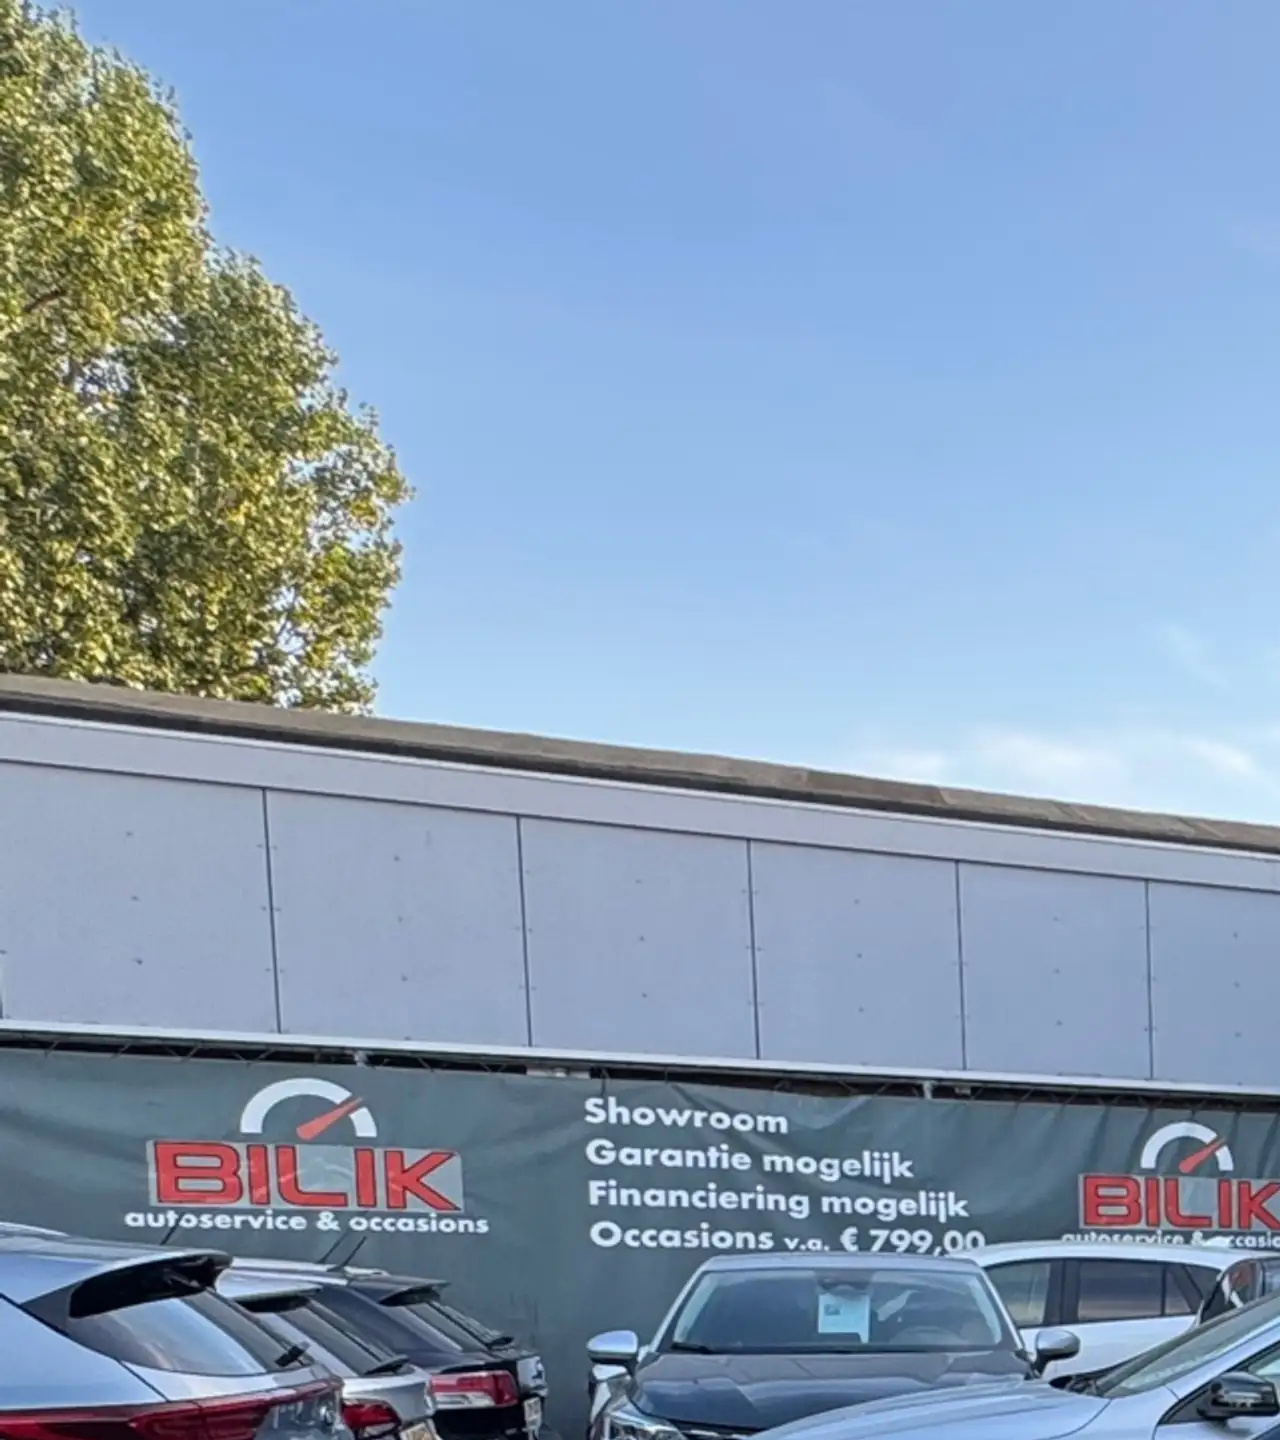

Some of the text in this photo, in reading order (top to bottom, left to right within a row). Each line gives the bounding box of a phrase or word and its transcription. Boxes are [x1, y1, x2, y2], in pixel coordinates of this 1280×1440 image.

[584, 1097, 788, 1134] Showroom
[153, 1140, 461, 1211] BILIK
[585, 1138, 914, 1184] Garantie mogelijk
[587, 1179, 969, 1223] Financiering mogelijk
[124, 1209, 489, 1234] autoservice & occasions
[589, 1221, 774, 1250] Occasions
[784, 1237, 829, 1252] v.a.
[868, 1228, 986, 1257] 799,00
[1191, 1230, 1205, 1246] &
